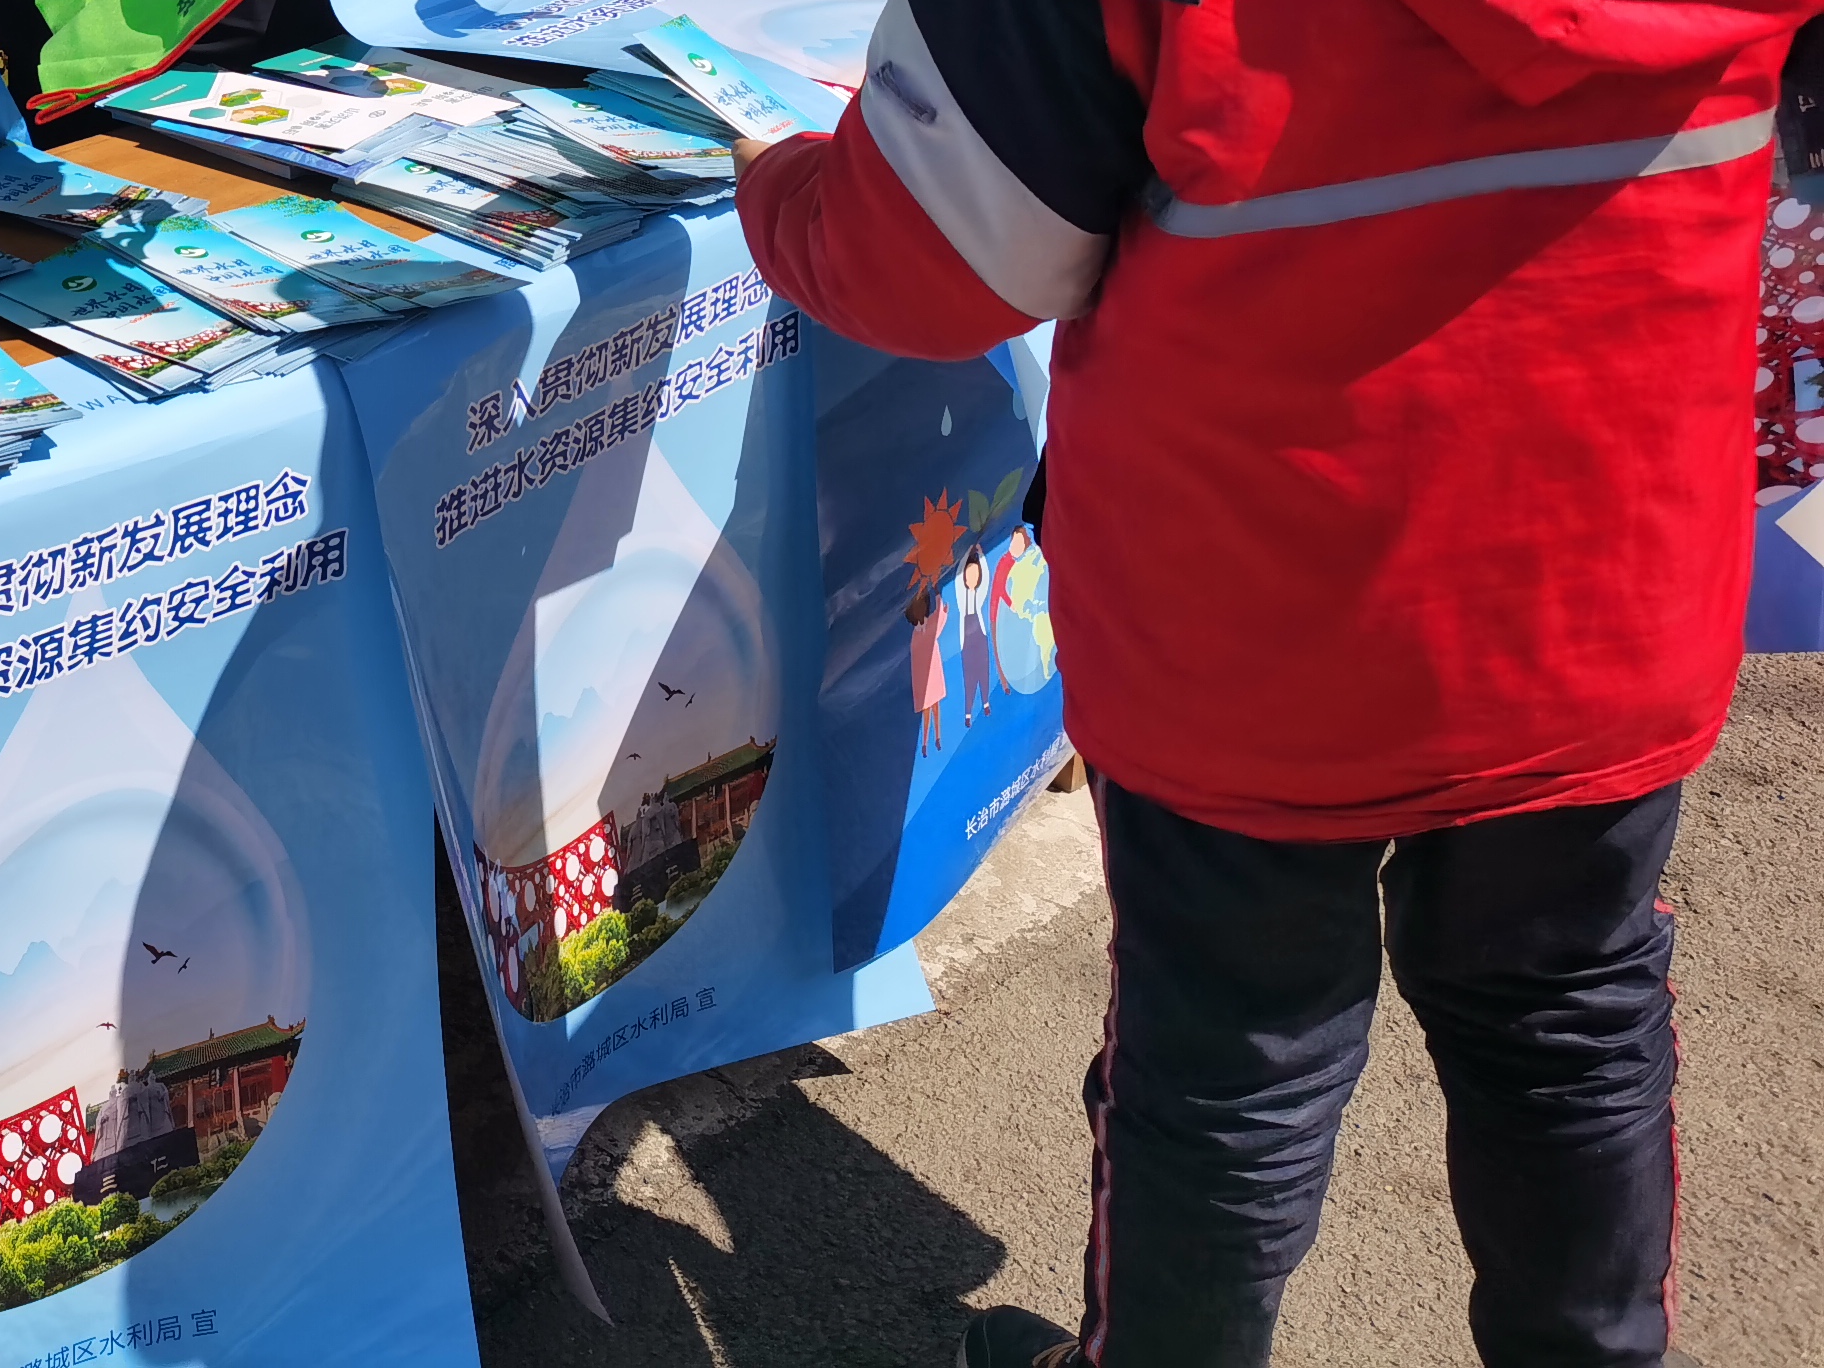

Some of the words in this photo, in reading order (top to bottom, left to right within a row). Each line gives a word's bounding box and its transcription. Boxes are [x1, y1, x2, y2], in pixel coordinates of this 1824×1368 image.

[305, 239, 378, 261] 世界水日
[332, 244, 410, 267] 中国水周
[177, 258, 251, 276] 世界水日
[203, 265, 285, 283] 中国水周
[70, 283, 143, 317] 世界水日
[99, 285, 177, 319] 中国水周
[466, 266, 775, 454] 深入贯彻新发展理念
[434, 311, 801, 548] 推进水资源集约安全利用
[695, 986, 717, 1012] 宣
[190, 1308, 219, 1338] 宣
